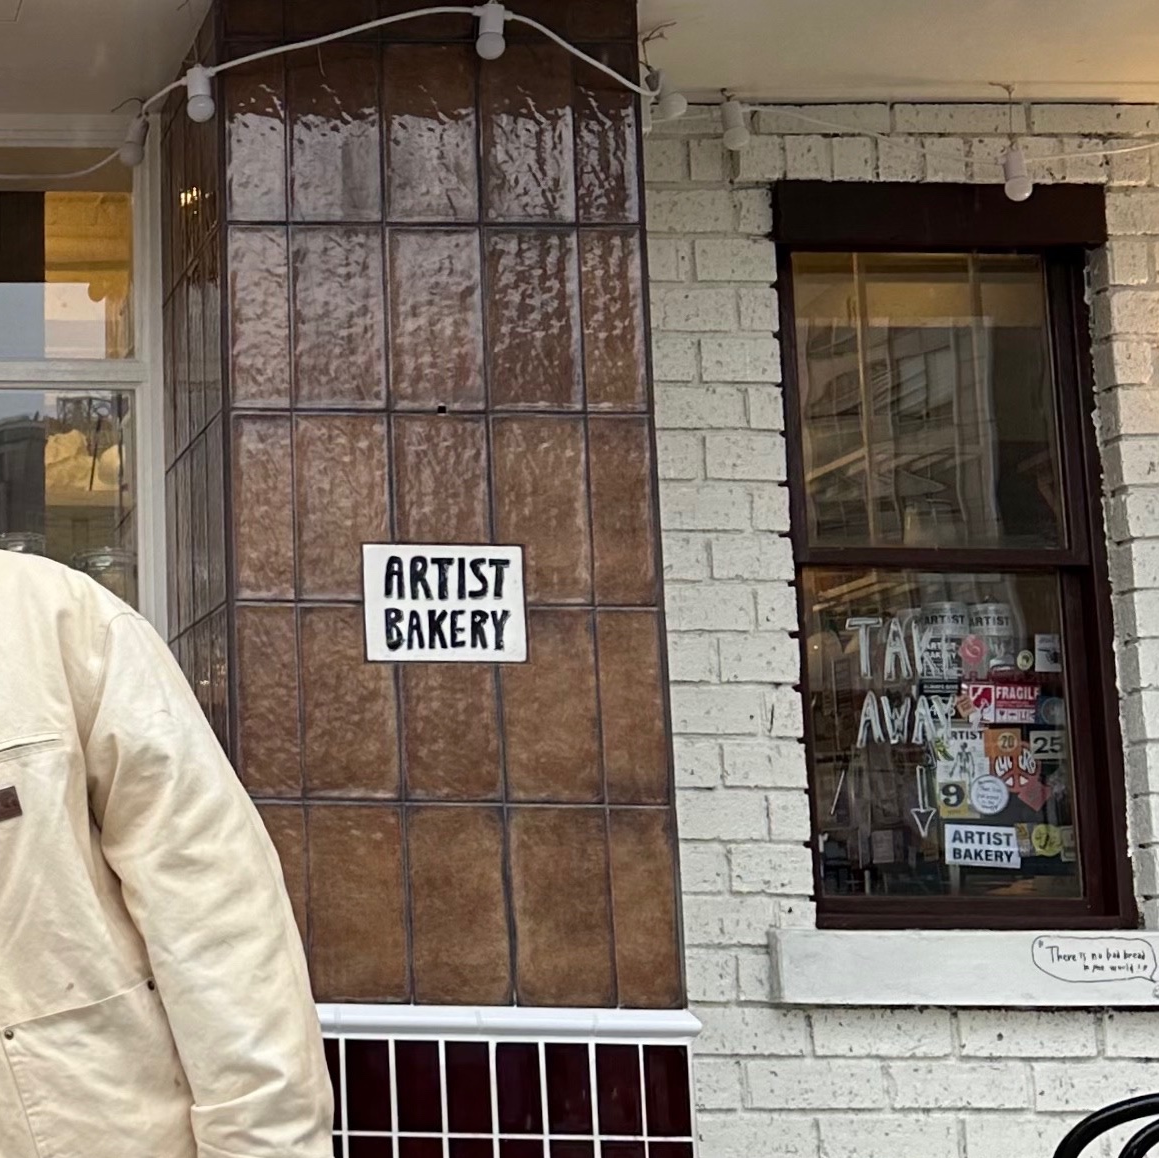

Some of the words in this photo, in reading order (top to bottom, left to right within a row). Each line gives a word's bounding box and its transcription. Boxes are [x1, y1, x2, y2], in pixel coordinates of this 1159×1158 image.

[384, 556, 510, 600] ARTIST
[924, 614, 965, 625] ARTIST
[968, 616, 1009, 627] ARTIST
[384, 608, 511, 651] BAKERY
[845, 617, 962, 681] TAKE
[856, 690, 956, 748] AWAY
[950, 731, 984, 740] RTIST
[1000, 735, 1015, 748] 20
[1033, 736, 1063, 754] 25
[941, 783, 965, 807] 9
[952, 829, 1013, 847] ARTIST
[952, 847, 1014, 864] BAKERY
[1091, 952, 1103, 960] no
[1106, 948, 1120, 961] bad
[1123, 950, 1145, 960] bread
